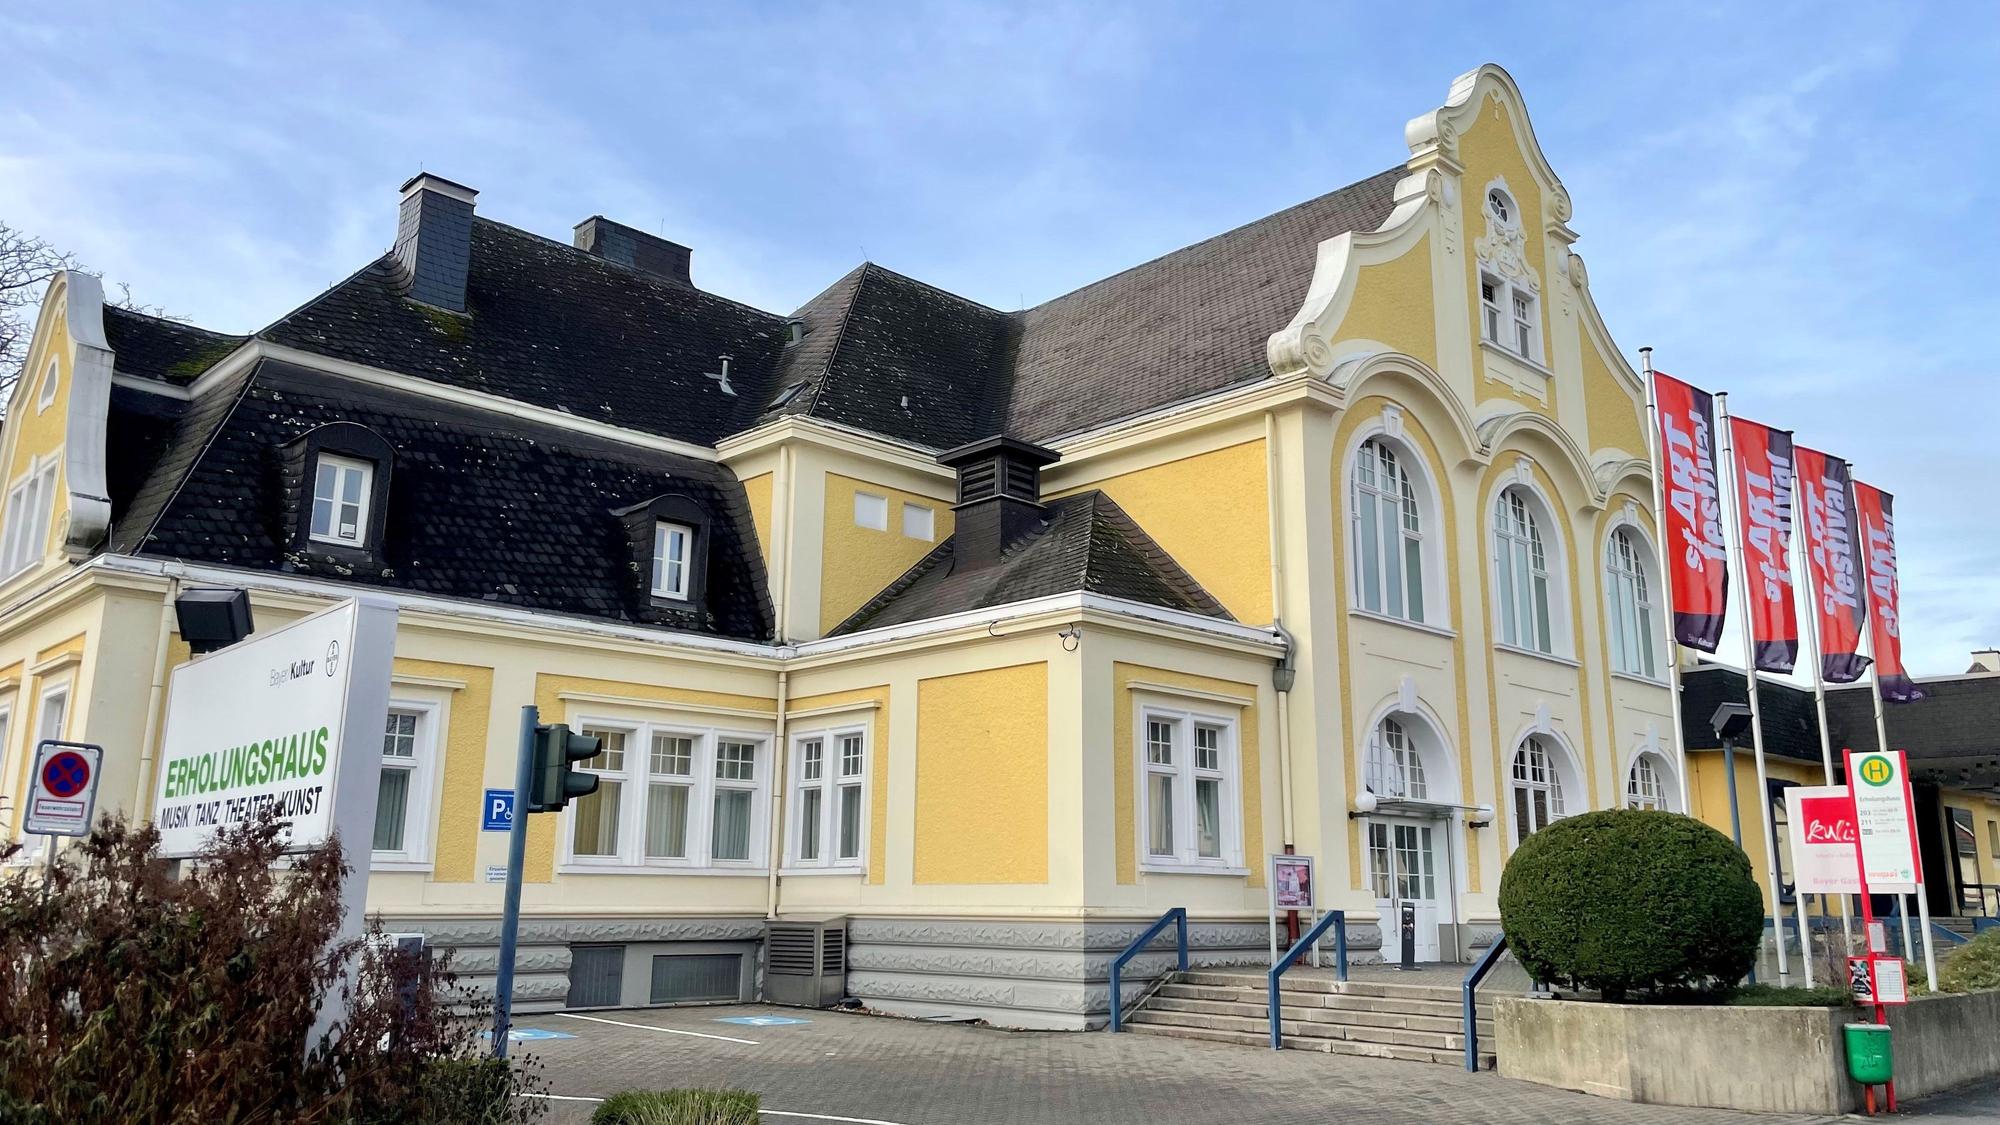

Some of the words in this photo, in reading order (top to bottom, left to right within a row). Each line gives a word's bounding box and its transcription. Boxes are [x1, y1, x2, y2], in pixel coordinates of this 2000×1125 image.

[1821, 475, 1857, 608] festival
[290, 659, 315, 680] Kultur
[165, 726, 329, 799] ERHOLUNGSHAUS
[1868, 761, 1884, 780] H
[160, 804, 191, 829] MUSIK
[195, 800, 220, 826] TANZ
[281, 786, 323, 818] KUNST
[491, 799, 506, 820] P
